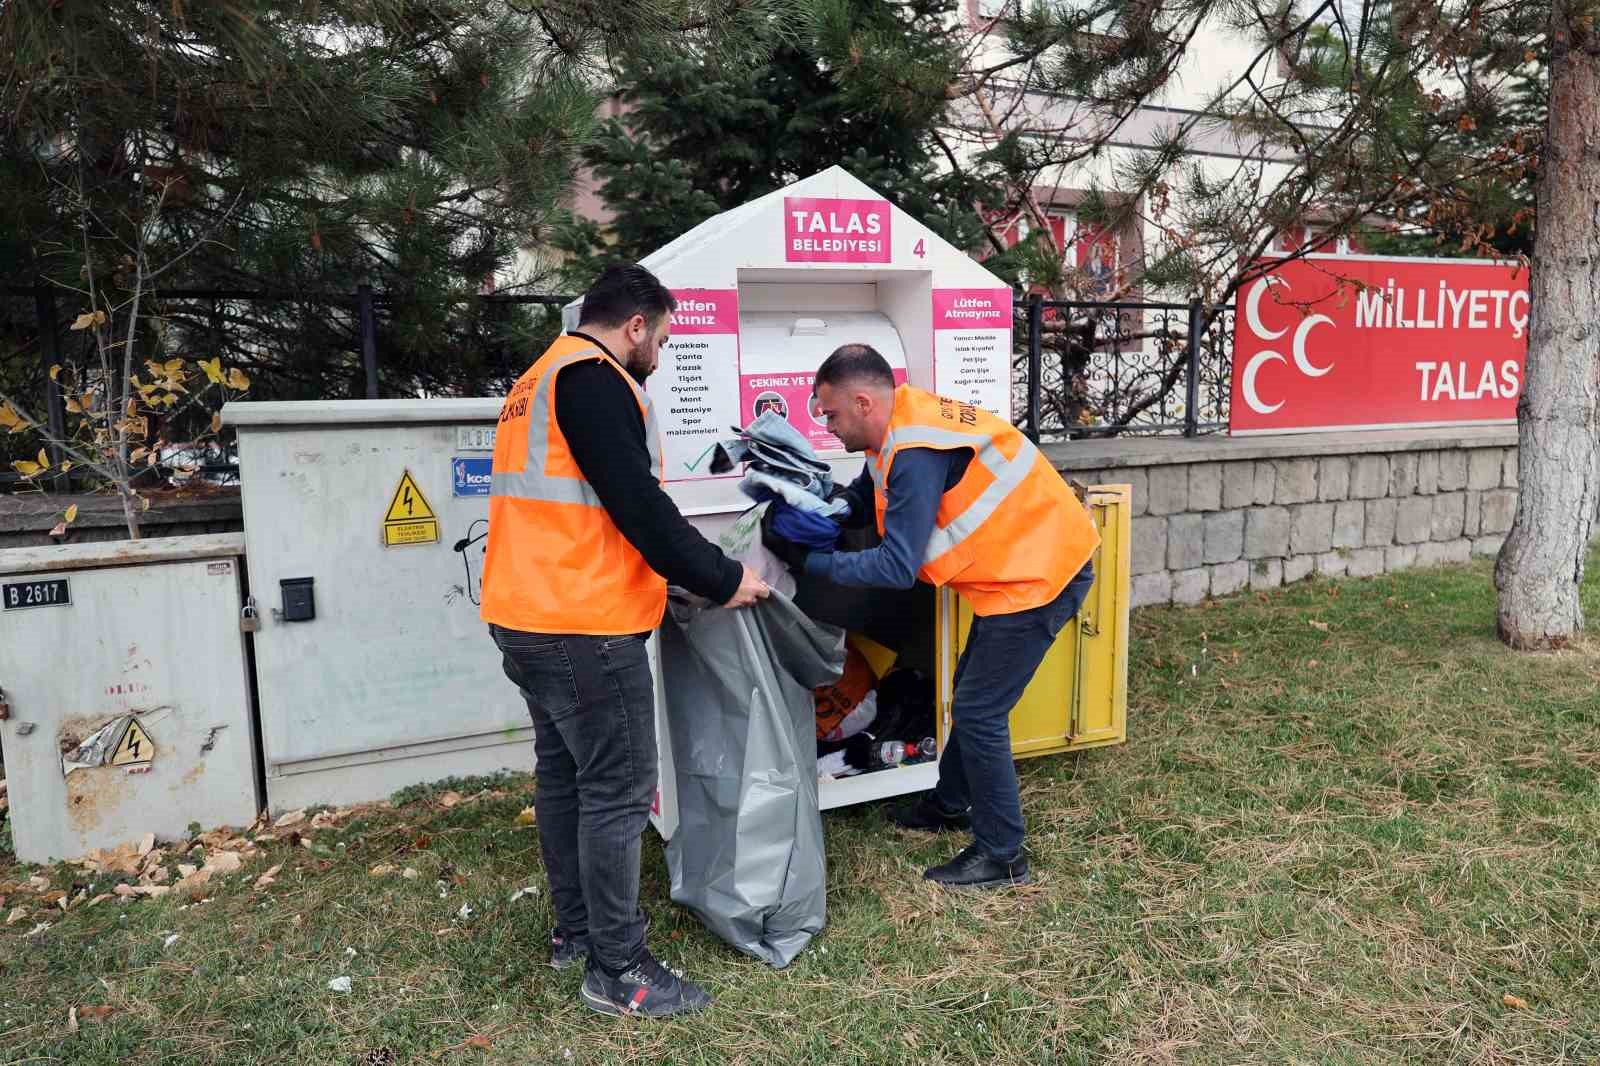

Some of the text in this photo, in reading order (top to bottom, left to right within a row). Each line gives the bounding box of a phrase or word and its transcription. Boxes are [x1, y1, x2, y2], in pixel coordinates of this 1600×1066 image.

[792, 211, 881, 234] TALAS
[793, 238, 881, 252] BELEDİYESİ
[913, 239, 926, 258] 4
[954, 298, 992, 308] Lütfen
[945, 310, 1000, 320] Atmayınız
[668, 342, 709, 350] Ayakkabı
[675, 354, 702, 362] Çanta
[676, 364, 702, 372] Kazak
[792, 377, 805, 386] VE
[1415, 360, 1520, 401] TALAS
[671, 385, 708, 393] Oyuncak
[670, 406, 711, 414] Battaniye
[682, 417, 701, 425] Spor
[666, 428, 718, 436] malzemeleri
[10, 583, 60, 605] B 2617
